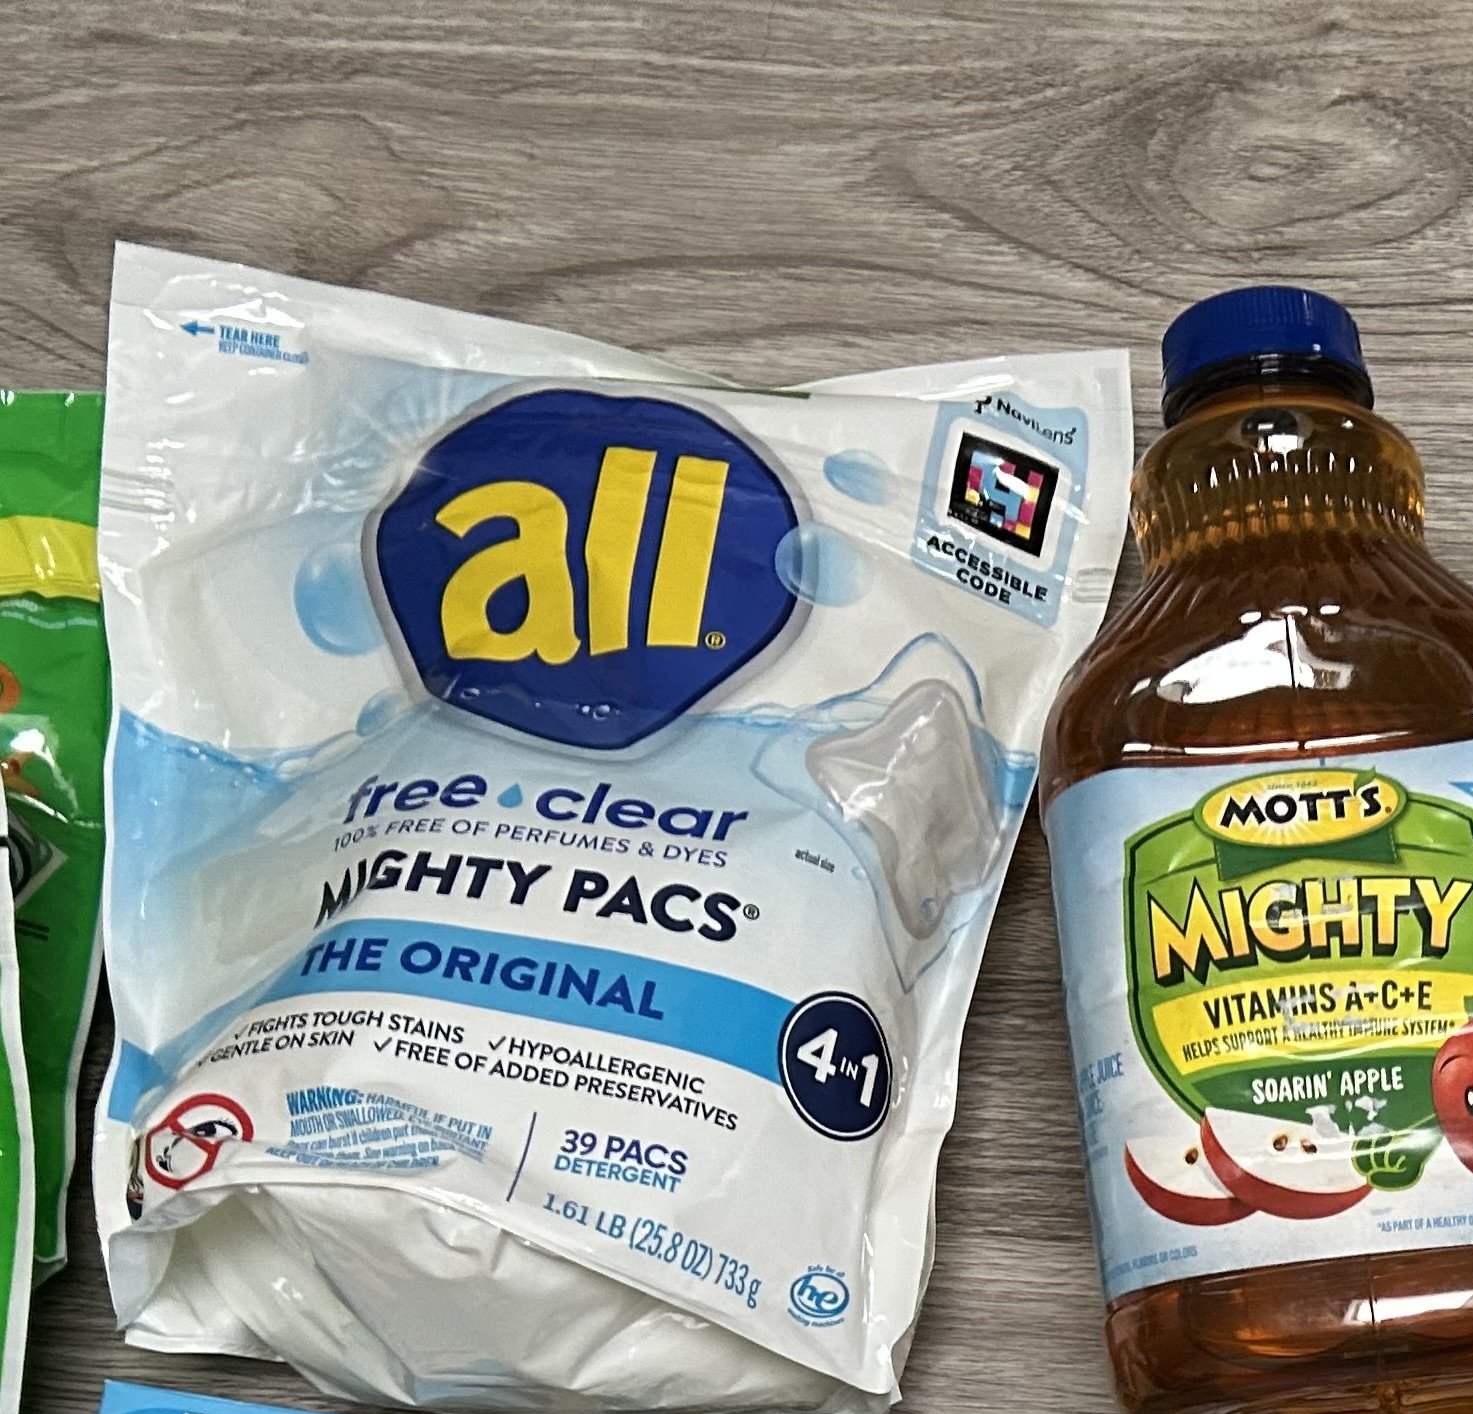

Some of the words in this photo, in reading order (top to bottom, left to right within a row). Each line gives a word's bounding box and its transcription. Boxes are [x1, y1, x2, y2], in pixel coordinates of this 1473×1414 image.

[219, 324, 247, 341] TEAR
[251, 331, 280, 348] HERE
[926, 536, 1048, 602] ACCESSIBLE
[956, 568, 1012, 605] CODE
[343, 774, 488, 825] free
[534, 782, 749, 842] clear
[1219, 785, 1382, 828] MOTT'S
[333, 823, 378, 853] 100%
[384, 817, 443, 838] FREE
[451, 819, 490, 838] OF
[494, 822, 630, 855] PERFUMES
[637, 841, 655, 858] &
[663, 844, 729, 868] DYES
[313, 848, 553, 930] MIGHTY
[300, 937, 389, 977] THE
[399, 940, 665, 1021] ORIGINAL
[1203, 981, 1337, 1030] VITAMINS
[1345, 979, 1432, 1013] A+C+E
[210, 1035, 272, 1063] GENTLE
[274, 1033, 306, 1051] ON
[307, 1030, 355, 1047] SKIN
[248, 1012, 308, 1036] FIGHTS
[312, 1010, 384, 1028] TOUGH
[387, 1013, 465, 1044] STAINS
[394, 1039, 451, 1067] FREE
[454, 1051, 488, 1072] OF
[489, 1059, 569, 1088] ADDED
[574, 1074, 739, 1131] PRESERVATIVES
[508, 1037, 706, 1095] HYPOALLERGENIC
[796, 1027, 838, 1084] 4
[839, 1056, 860, 1081] IN
[859, 1053, 880, 1109] 1
[1252, 1070, 1333, 1105] SOARIN'
[1340, 1066, 1404, 1096] APPLE
[286, 1086, 363, 1116] WARNING:
[553, 1154, 682, 1194] DETERGENT
[560, 1129, 598, 1157] 39
[603, 1134, 690, 1177] PACS
[542, 1192, 589, 1226] 1.61
[595, 1210, 627, 1241] LB
[628, 1216, 684, 1264] (25.8
[680, 1238, 714, 1282] OZ)
[714, 1252, 750, 1297] 733
[746, 1276, 763, 1311] g
